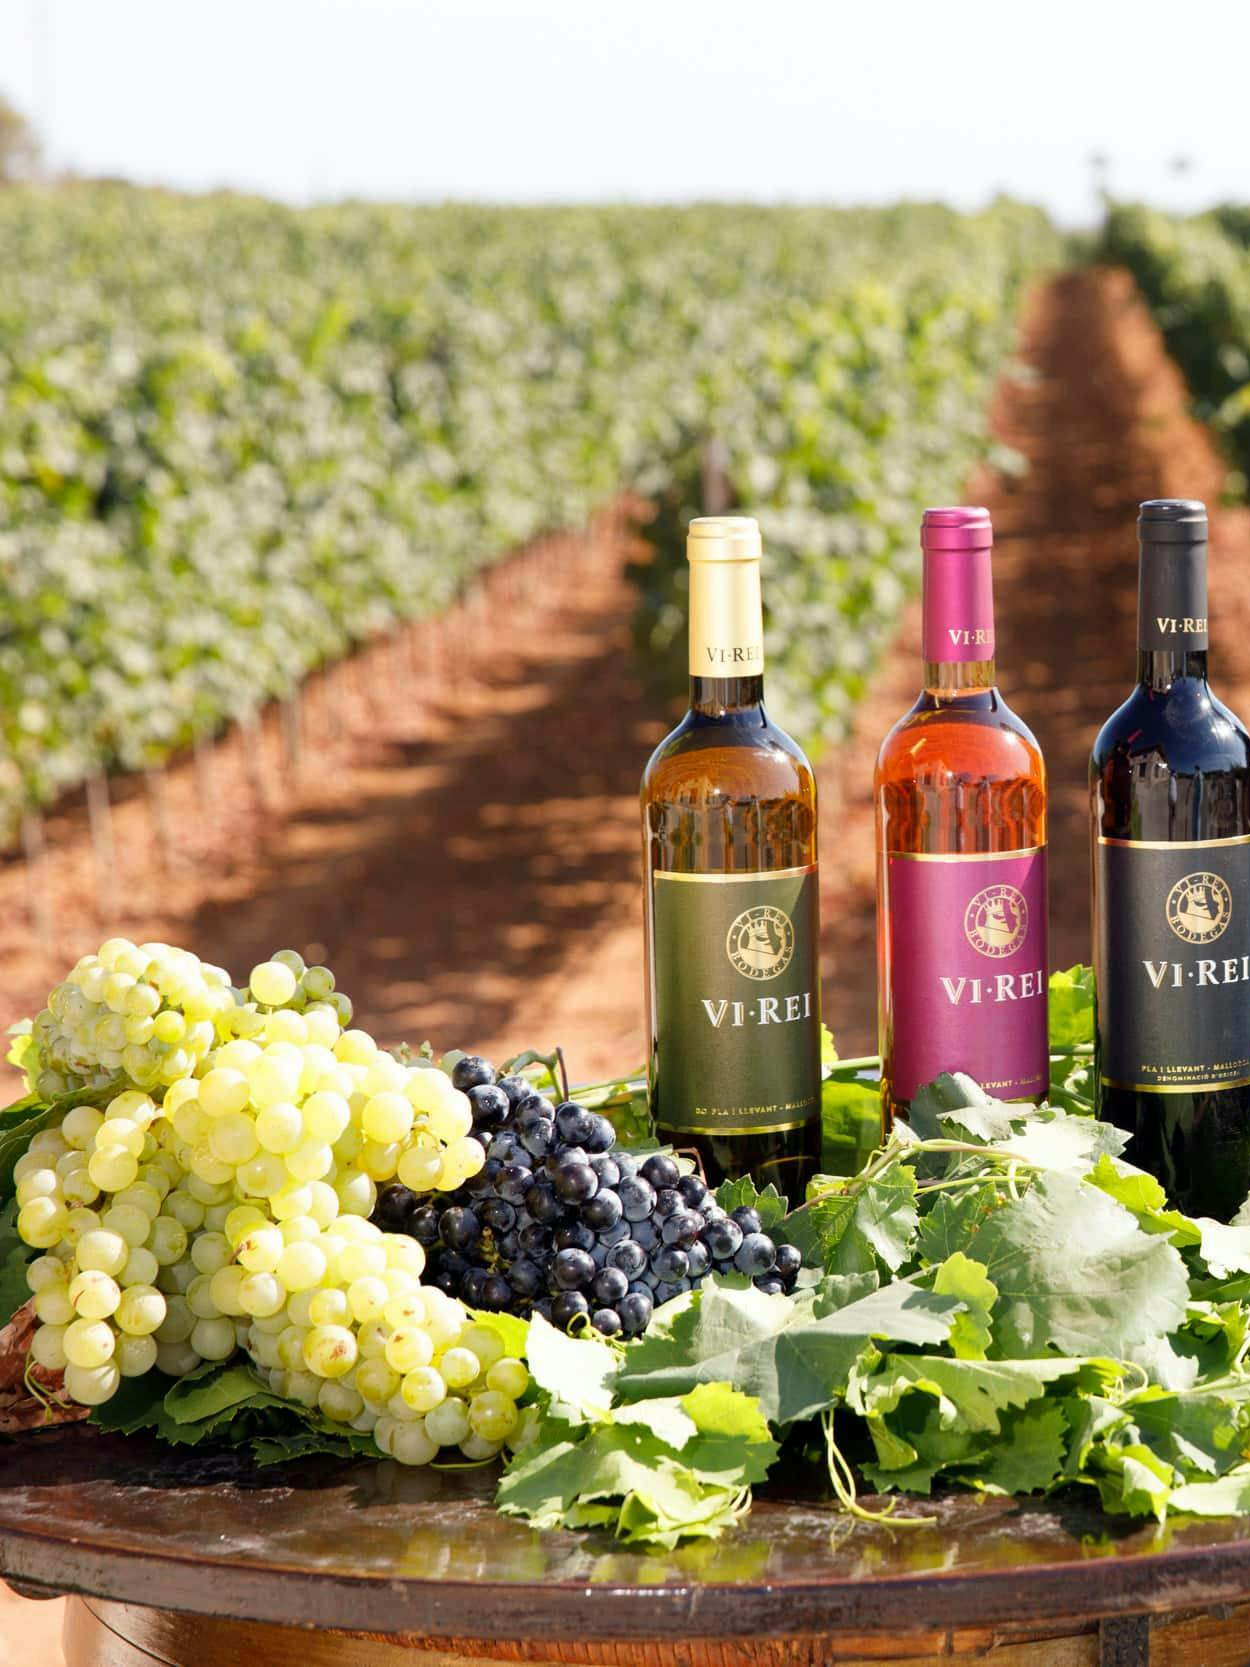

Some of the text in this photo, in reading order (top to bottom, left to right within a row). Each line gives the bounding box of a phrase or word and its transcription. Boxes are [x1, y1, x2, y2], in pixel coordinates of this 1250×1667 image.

[1170, 911, 1230, 942] BODEGAS
[730, 945, 793, 978] BODEGAS
[1141, 955, 1250, 989] VI·REI
[939, 969, 1045, 1006] VI·REI
[701, 992, 811, 1028] VI·REI
